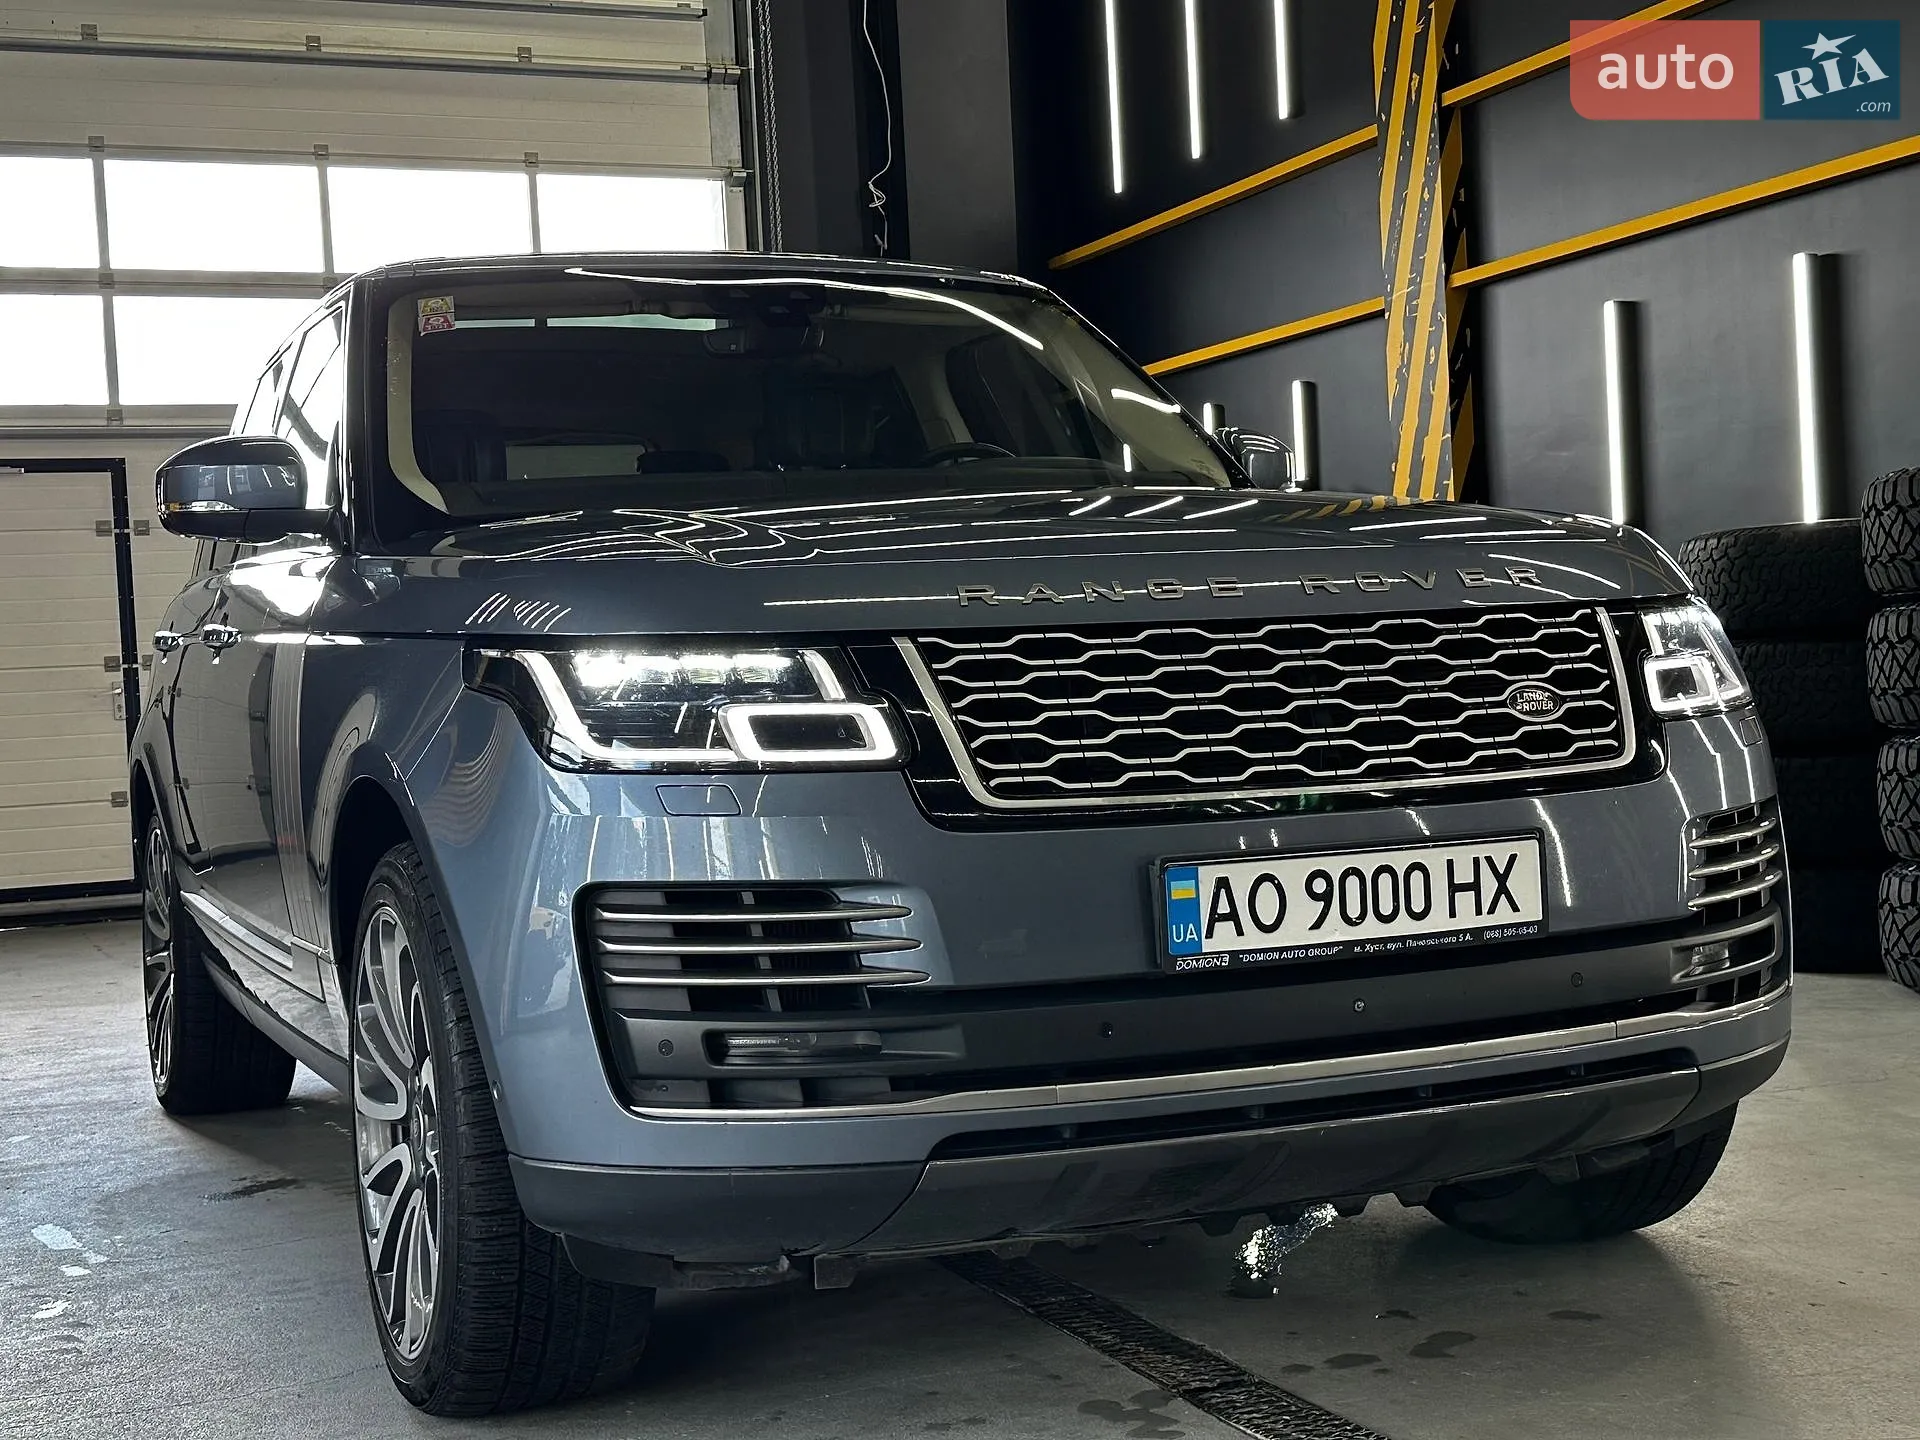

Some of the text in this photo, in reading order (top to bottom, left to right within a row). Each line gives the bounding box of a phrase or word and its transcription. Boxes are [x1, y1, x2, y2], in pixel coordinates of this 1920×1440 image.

[956, 566, 1543, 606] RANGE ROVER
[1516, 692, 1544, 702] LAND
[1523, 701, 1554, 712] ROVER
[1204, 852, 1521, 940] AO 9000 HX
[1172, 922, 1198, 944] UA
[1281, 950, 1306, 960] AUTO
